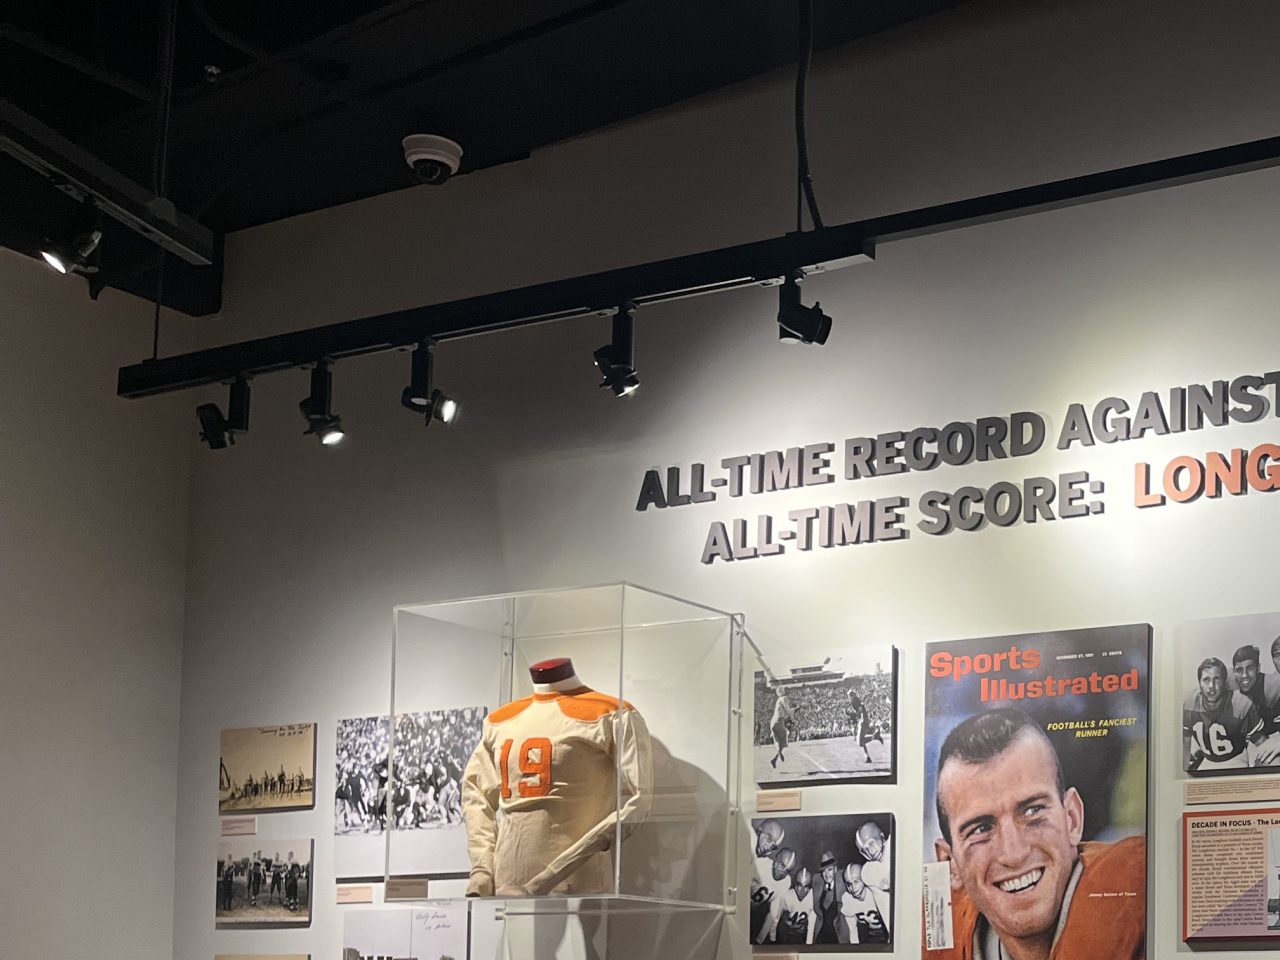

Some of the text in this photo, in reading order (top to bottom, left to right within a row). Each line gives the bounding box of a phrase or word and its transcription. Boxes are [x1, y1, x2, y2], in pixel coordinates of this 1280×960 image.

[636, 442, 835, 511] ALL-TIME
[845, 411, 1045, 480] RECORD
[701, 496, 909, 564] ALL-TIME
[917, 471, 1104, 535] SCORE:
[929, 646, 1040, 681] Sports
[980, 669, 1138, 701] Illustrated
[1047, 717, 1137, 731] FOOTBALL'S FANCIEST
[1075, 729, 1108, 739] RUNNER
[1191, 721, 1234, 757] 16
[498, 737, 553, 798] 19
[1191, 820, 1218, 828] DECADE
[1229, 819, 1252, 827] FOCUS
[1257, 818, 1270, 826] The
